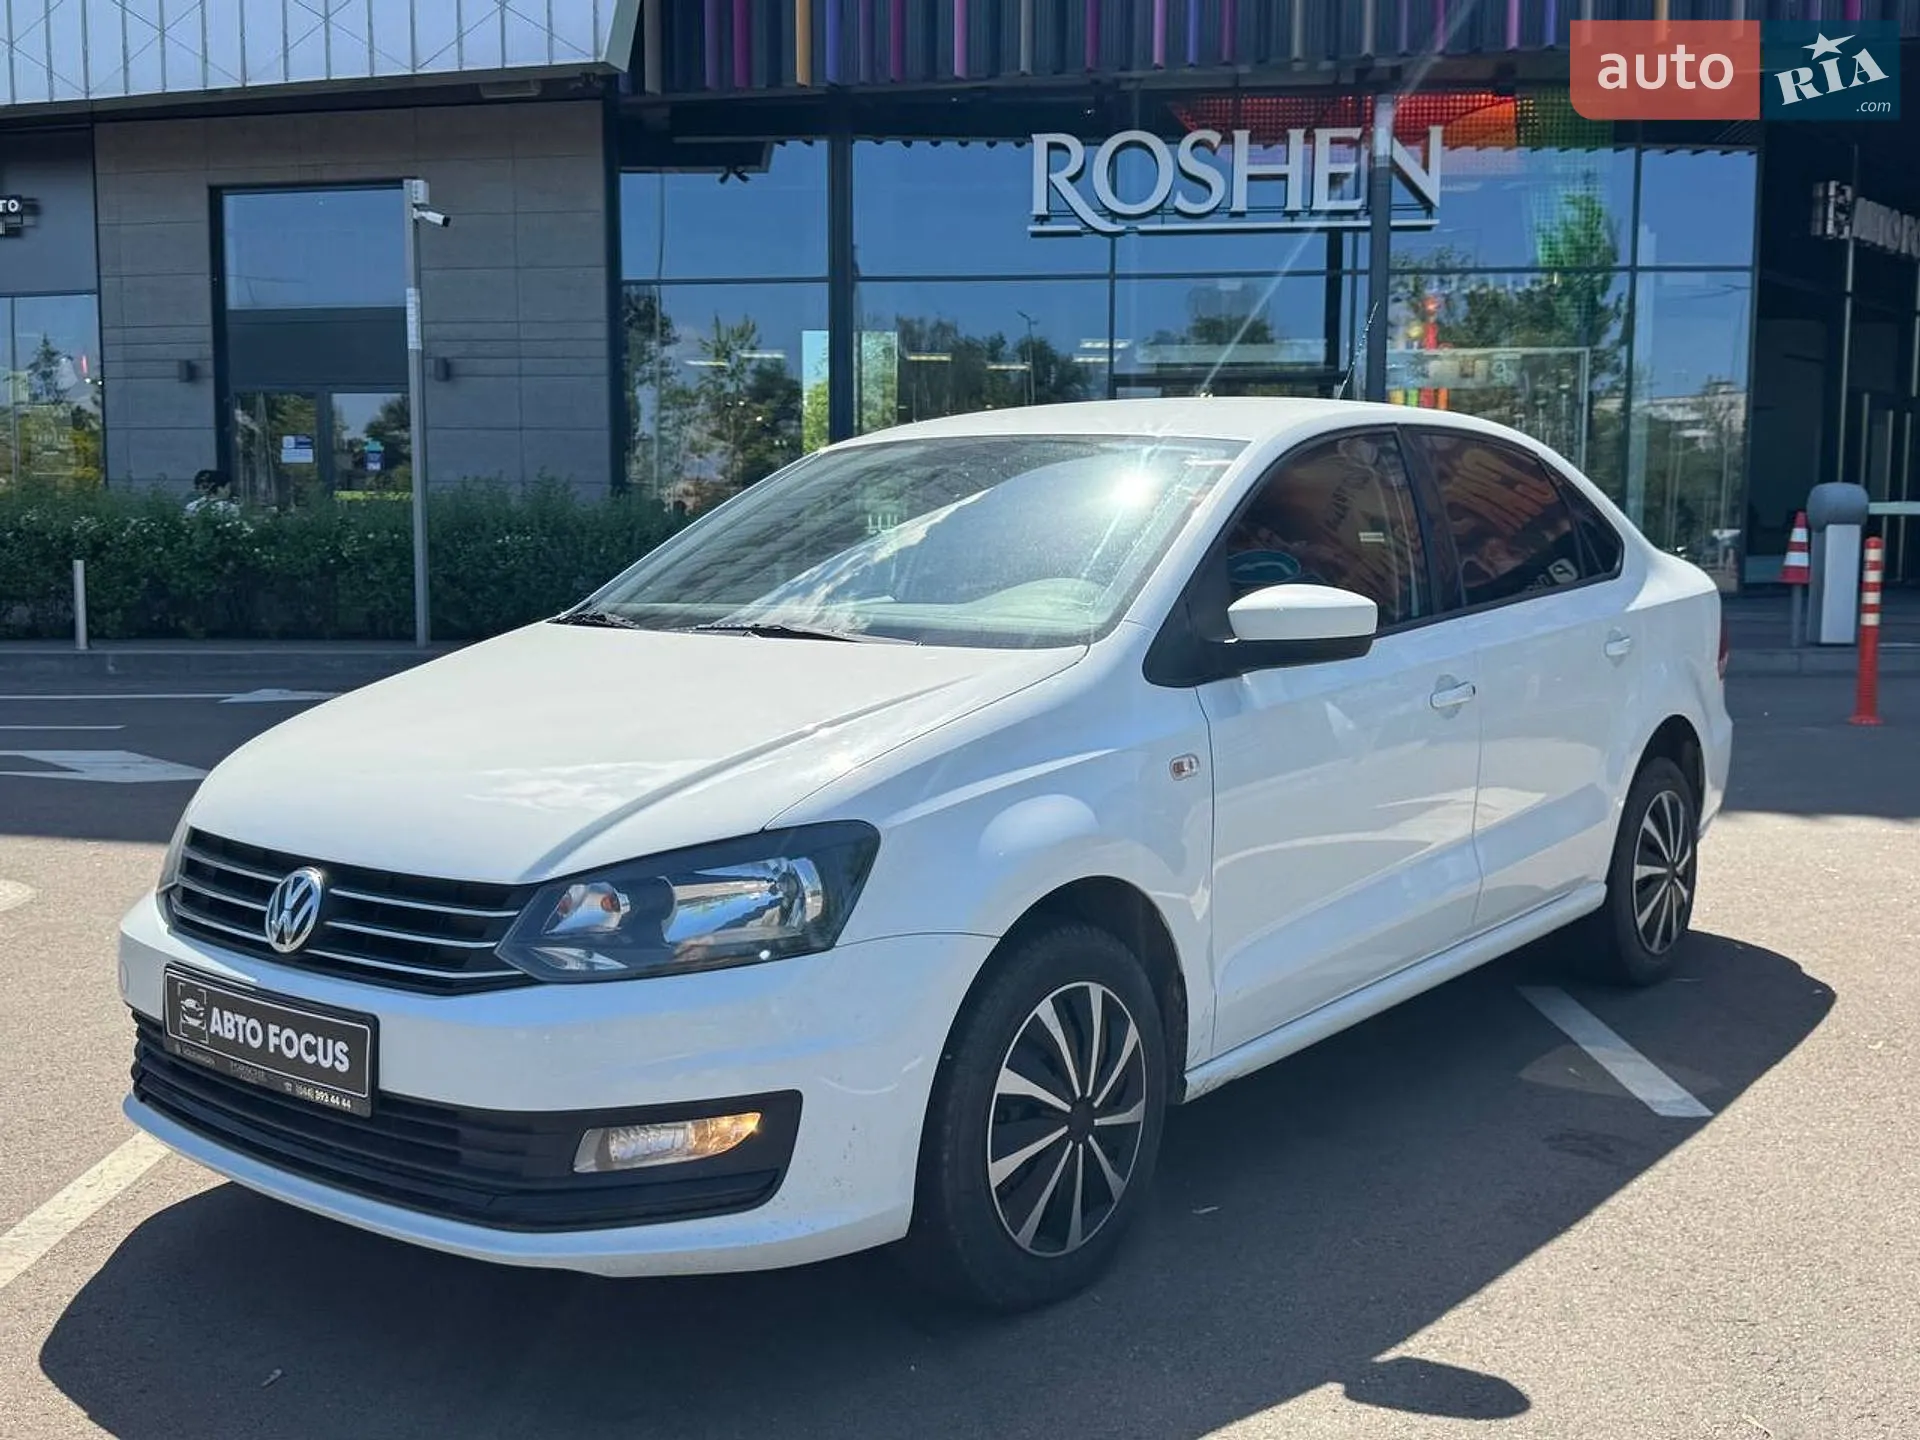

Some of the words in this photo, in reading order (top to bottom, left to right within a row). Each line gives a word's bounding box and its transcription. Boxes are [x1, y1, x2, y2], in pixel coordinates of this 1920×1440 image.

[1031, 125, 1443, 233] ROSHEN
[209, 1007, 263, 1049] АВТО
[268, 1023, 350, 1073] FOCUS
